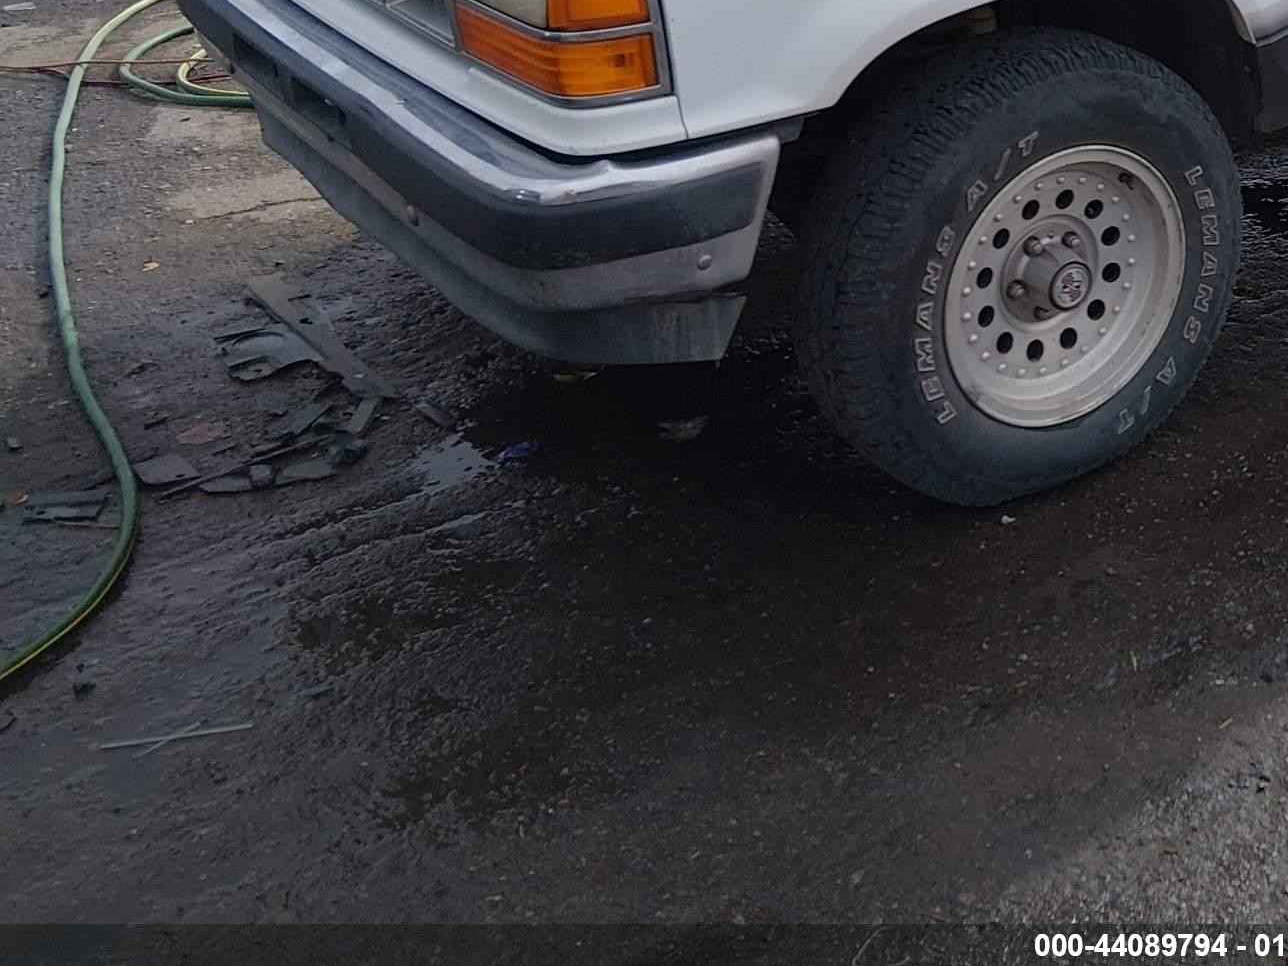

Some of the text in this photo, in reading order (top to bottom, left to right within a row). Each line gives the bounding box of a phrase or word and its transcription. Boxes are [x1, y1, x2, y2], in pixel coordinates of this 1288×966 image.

[914, 131, 1040, 425] LEMANS A/T
[1117, 164, 1220, 435] LEMANS A/T
